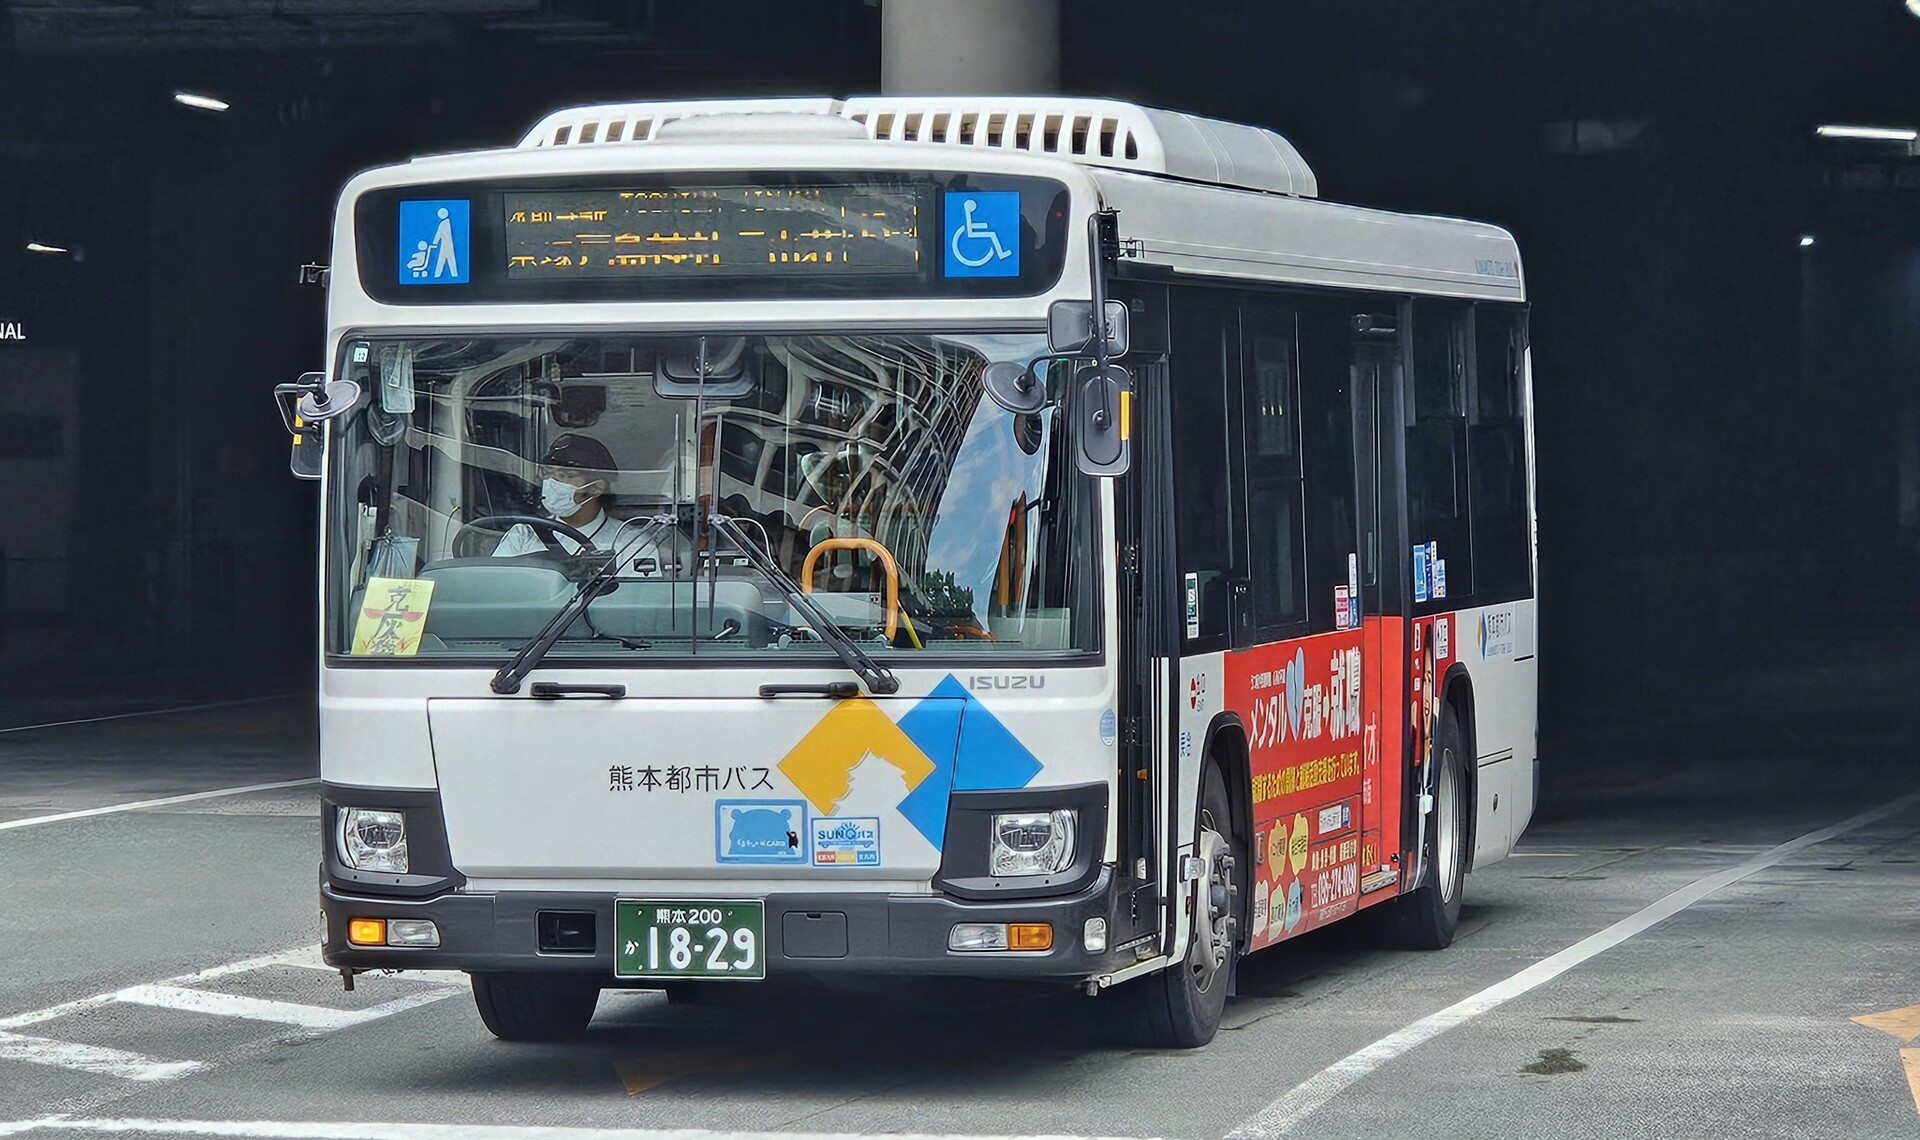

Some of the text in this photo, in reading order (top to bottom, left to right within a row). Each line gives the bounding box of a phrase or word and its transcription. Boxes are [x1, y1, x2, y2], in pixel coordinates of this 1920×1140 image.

[969, 675, 1045, 690] ISUZU
[1249, 691, 1288, 754] メンタル
[608, 764, 775, 794] 熊本都市バス
[624, 926, 756, 971] か 18-29
